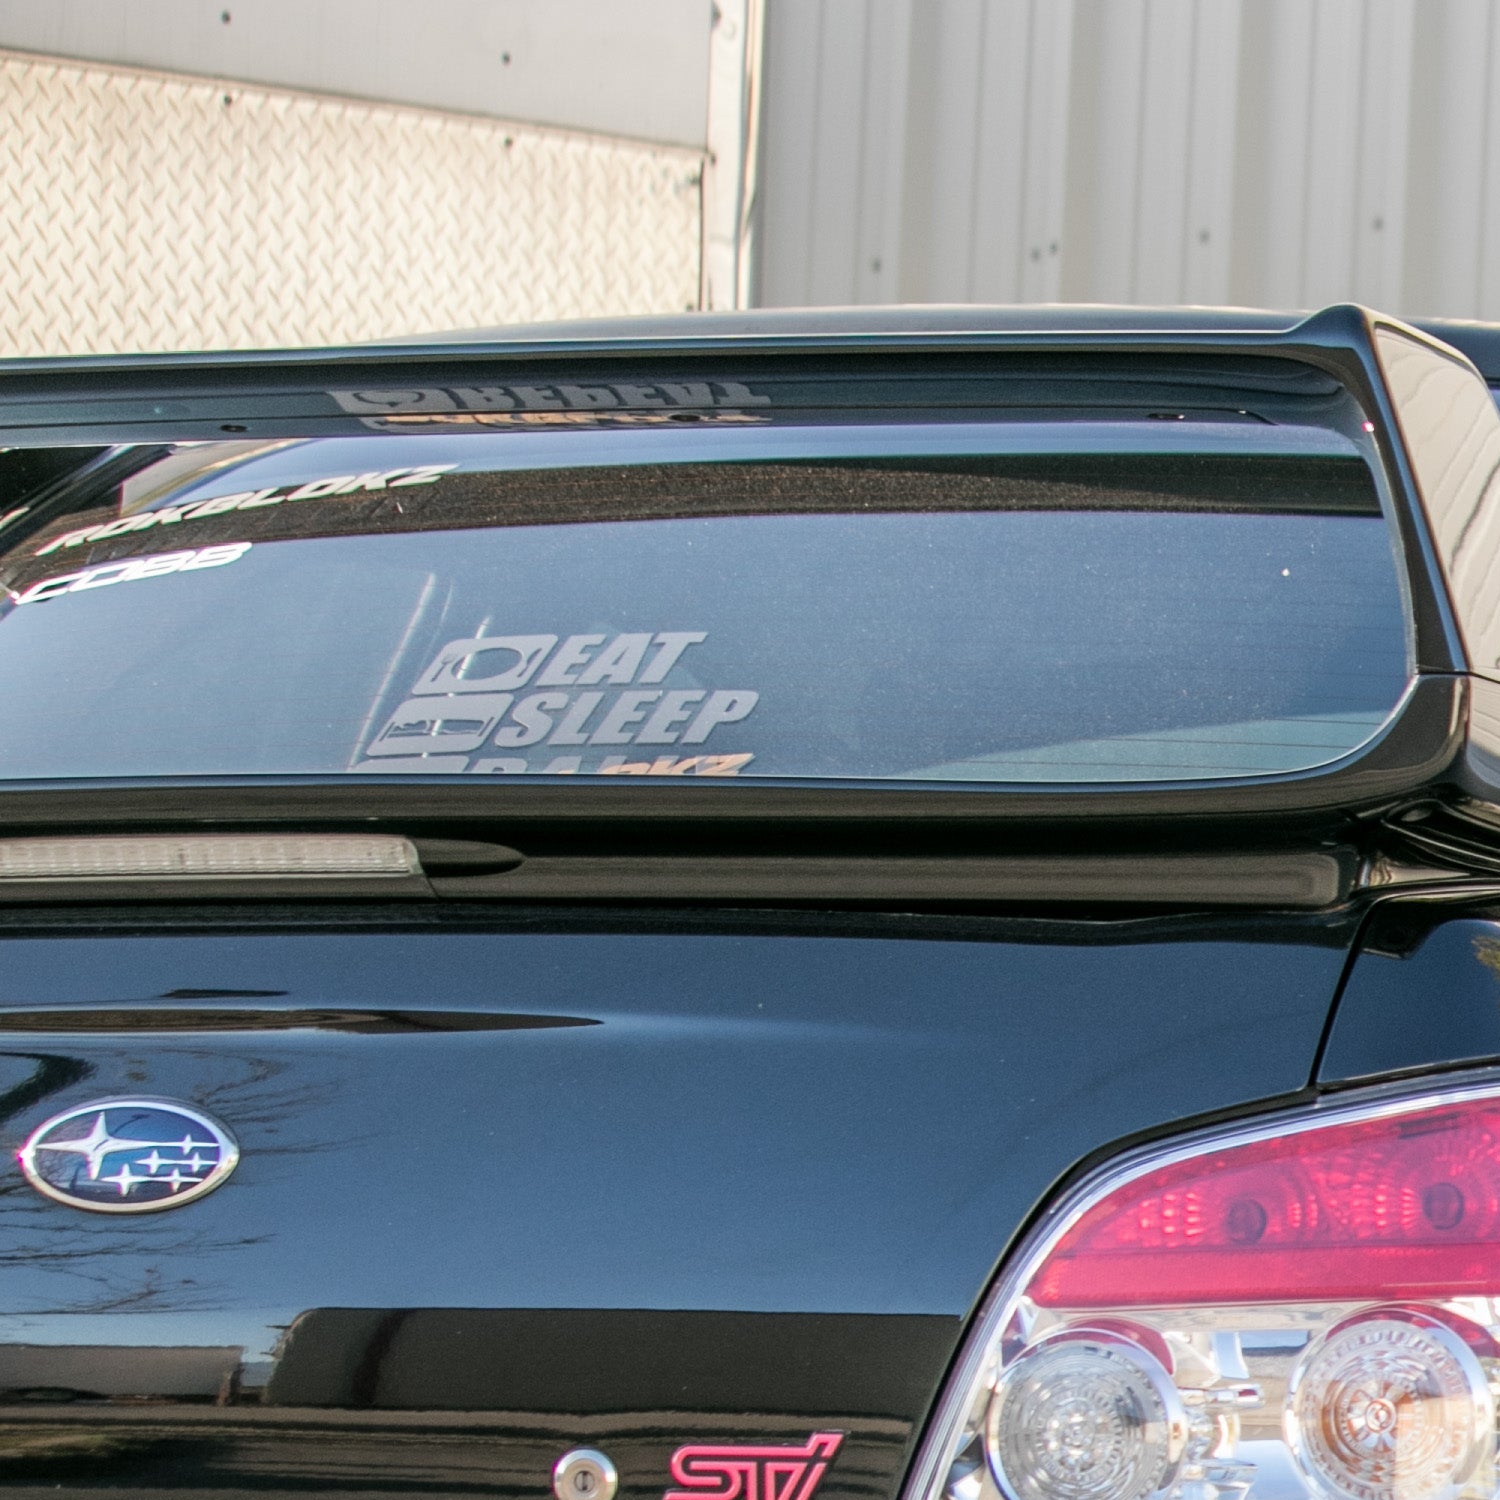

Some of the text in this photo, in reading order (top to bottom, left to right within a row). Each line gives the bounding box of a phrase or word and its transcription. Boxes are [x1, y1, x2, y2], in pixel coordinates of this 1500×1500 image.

[36, 463, 460, 556] ROKBLOKZ
[16, 541, 252, 604] COBB
[535, 631, 708, 687] EAT
[494, 690, 760, 748] SLEEP
